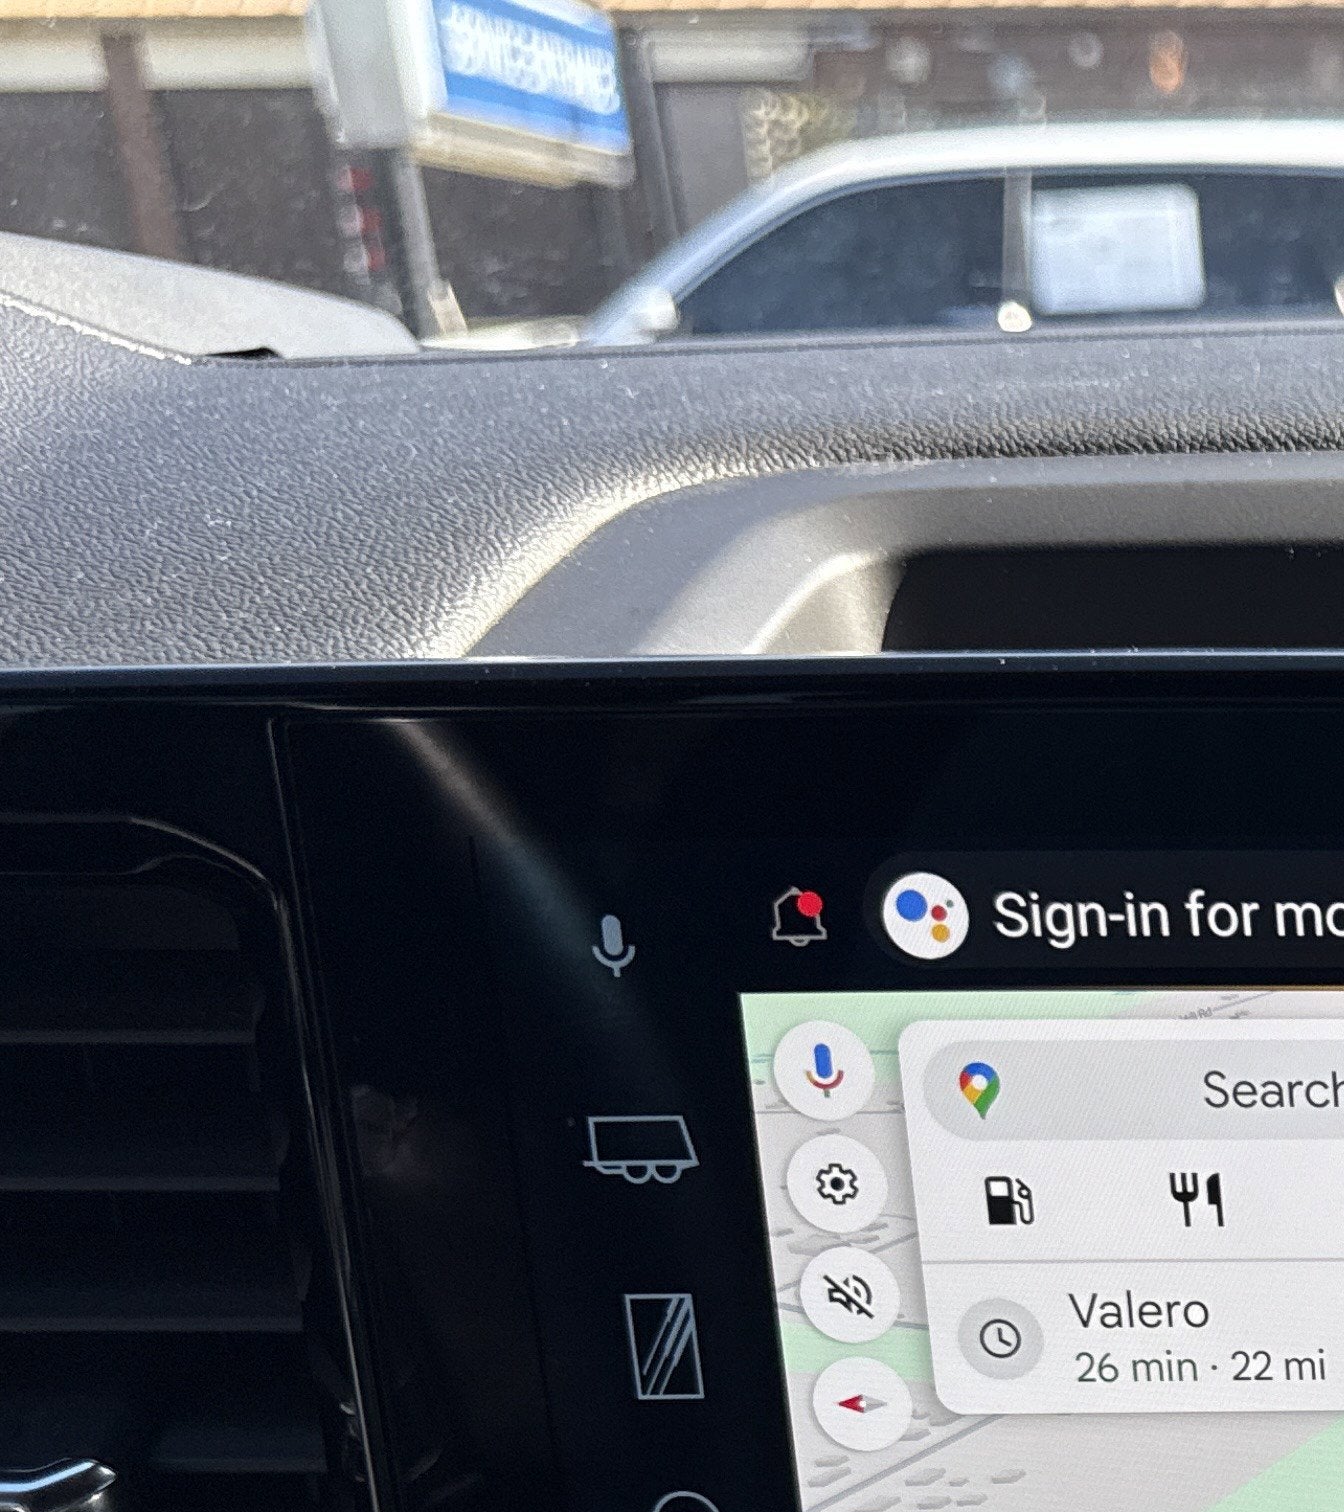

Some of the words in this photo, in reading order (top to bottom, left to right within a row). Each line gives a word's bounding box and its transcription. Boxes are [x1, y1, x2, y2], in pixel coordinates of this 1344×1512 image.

[994, 890, 1170, 947] Sign-in
[1187, 891, 1260, 939] for
[1068, 1290, 1211, 1332] Valero
[1075, 1351, 1119, 1384] 26
[1131, 1350, 1199, 1383] min
[1230, 1350, 1274, 1382] 22
[1284, 1348, 1328, 1382] mi
